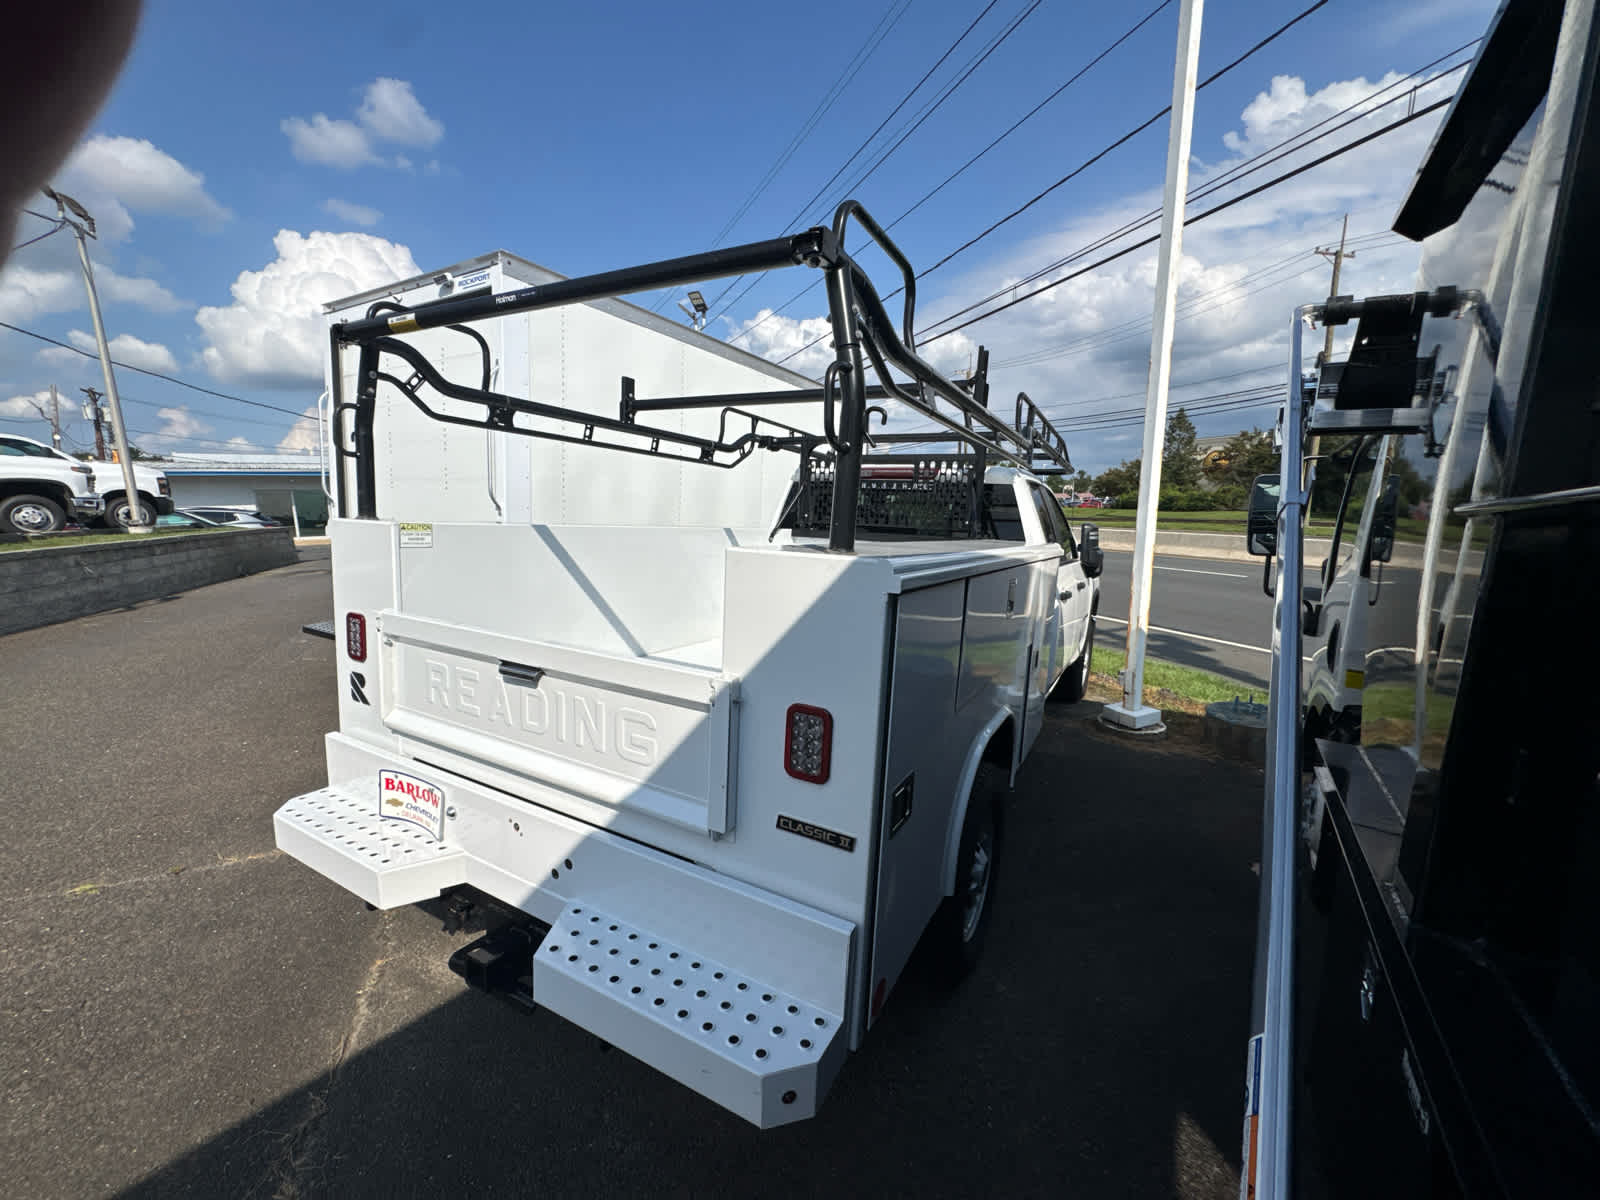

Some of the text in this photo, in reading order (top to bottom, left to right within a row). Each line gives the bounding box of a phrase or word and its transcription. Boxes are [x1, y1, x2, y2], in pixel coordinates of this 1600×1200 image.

[424, 658, 658, 767] READING
[384, 777, 440, 808] BARLOW
[405, 802, 439, 825] CHEVROLET
[779, 817, 837, 844] CLASSIC
